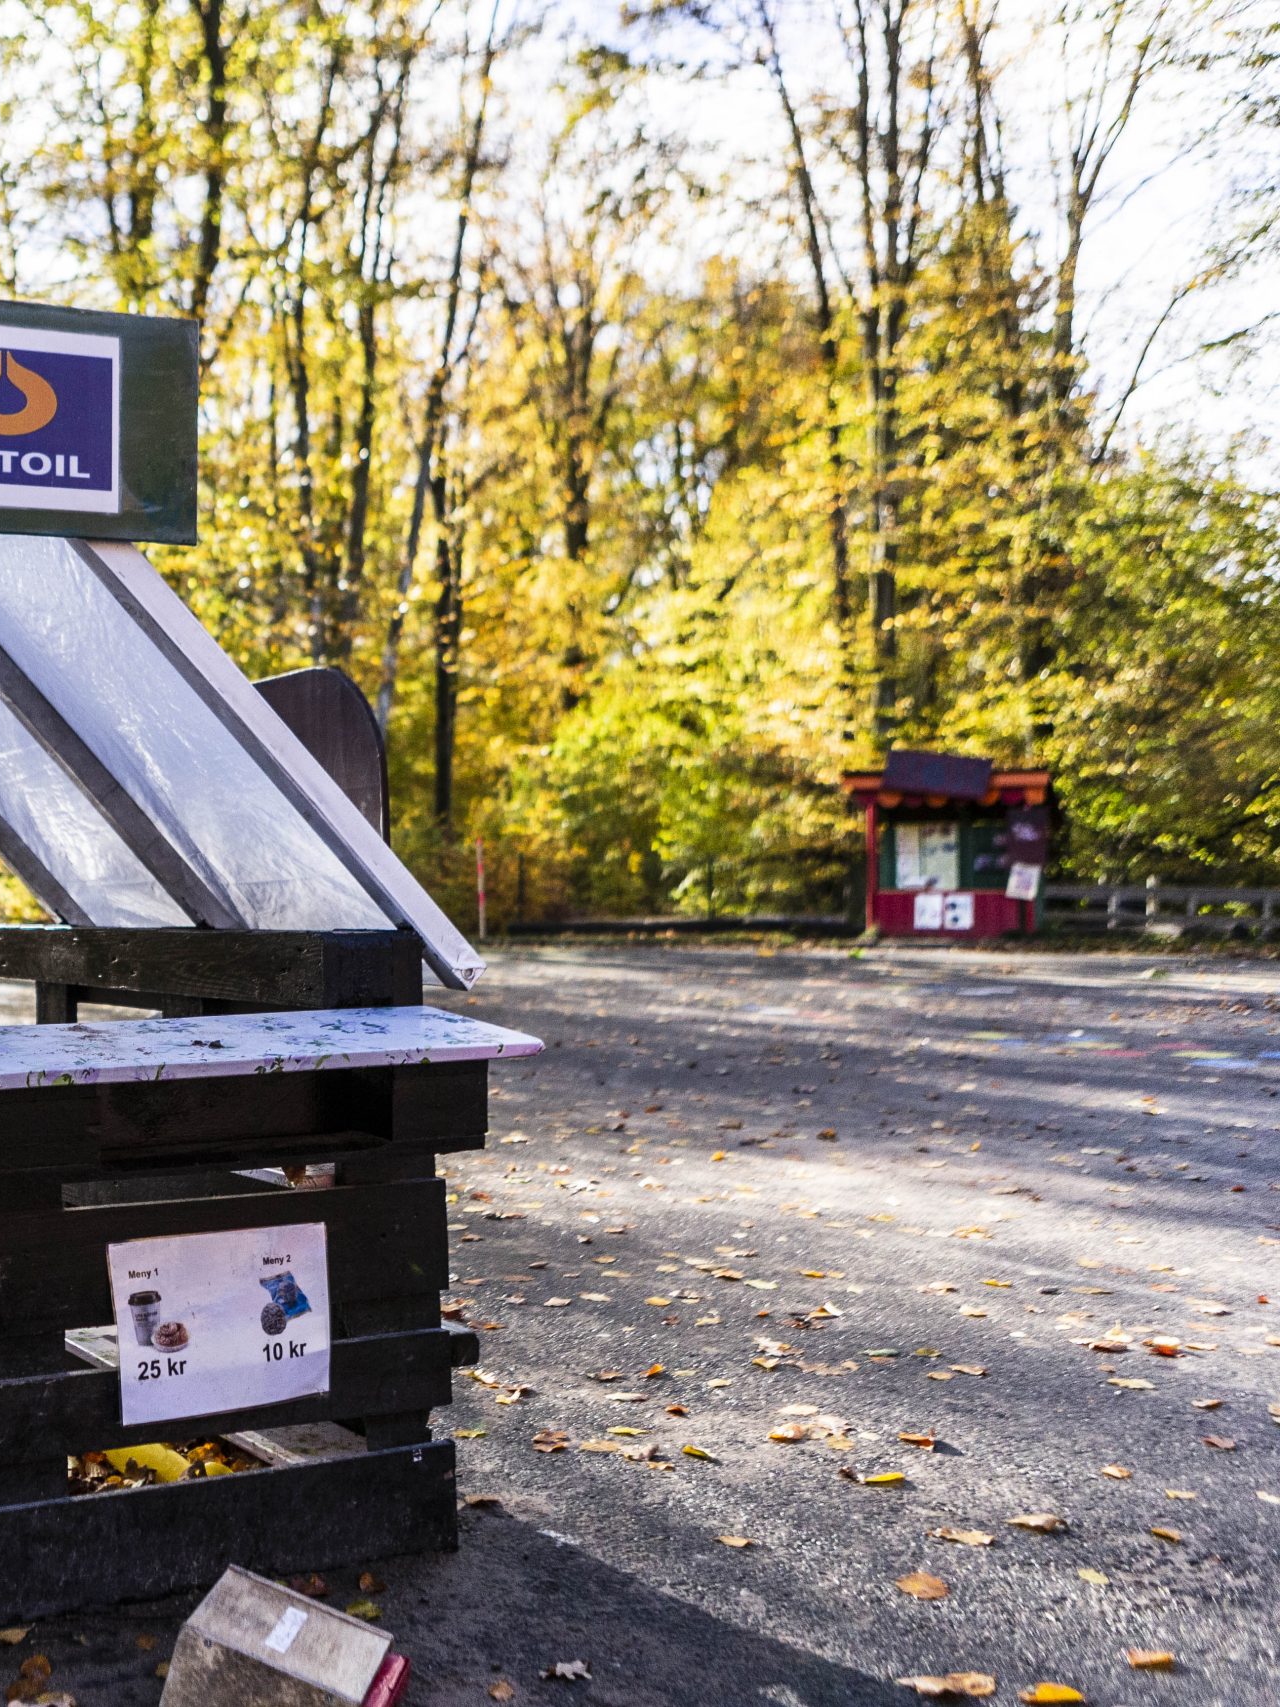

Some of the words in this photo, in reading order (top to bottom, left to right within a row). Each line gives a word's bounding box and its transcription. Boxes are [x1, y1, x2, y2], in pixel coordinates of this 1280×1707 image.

[262, 1256, 284, 1266] Meny
[286, 1254, 292, 1264] 2
[128, 1270, 152, 1280] Meny
[153, 1267, 159, 1277] 1
[262, 1342, 283, 1363] 10
[289, 1340, 308, 1359] kr
[137, 1359, 162, 1381] 25
[167, 1357, 187, 1377] kr
